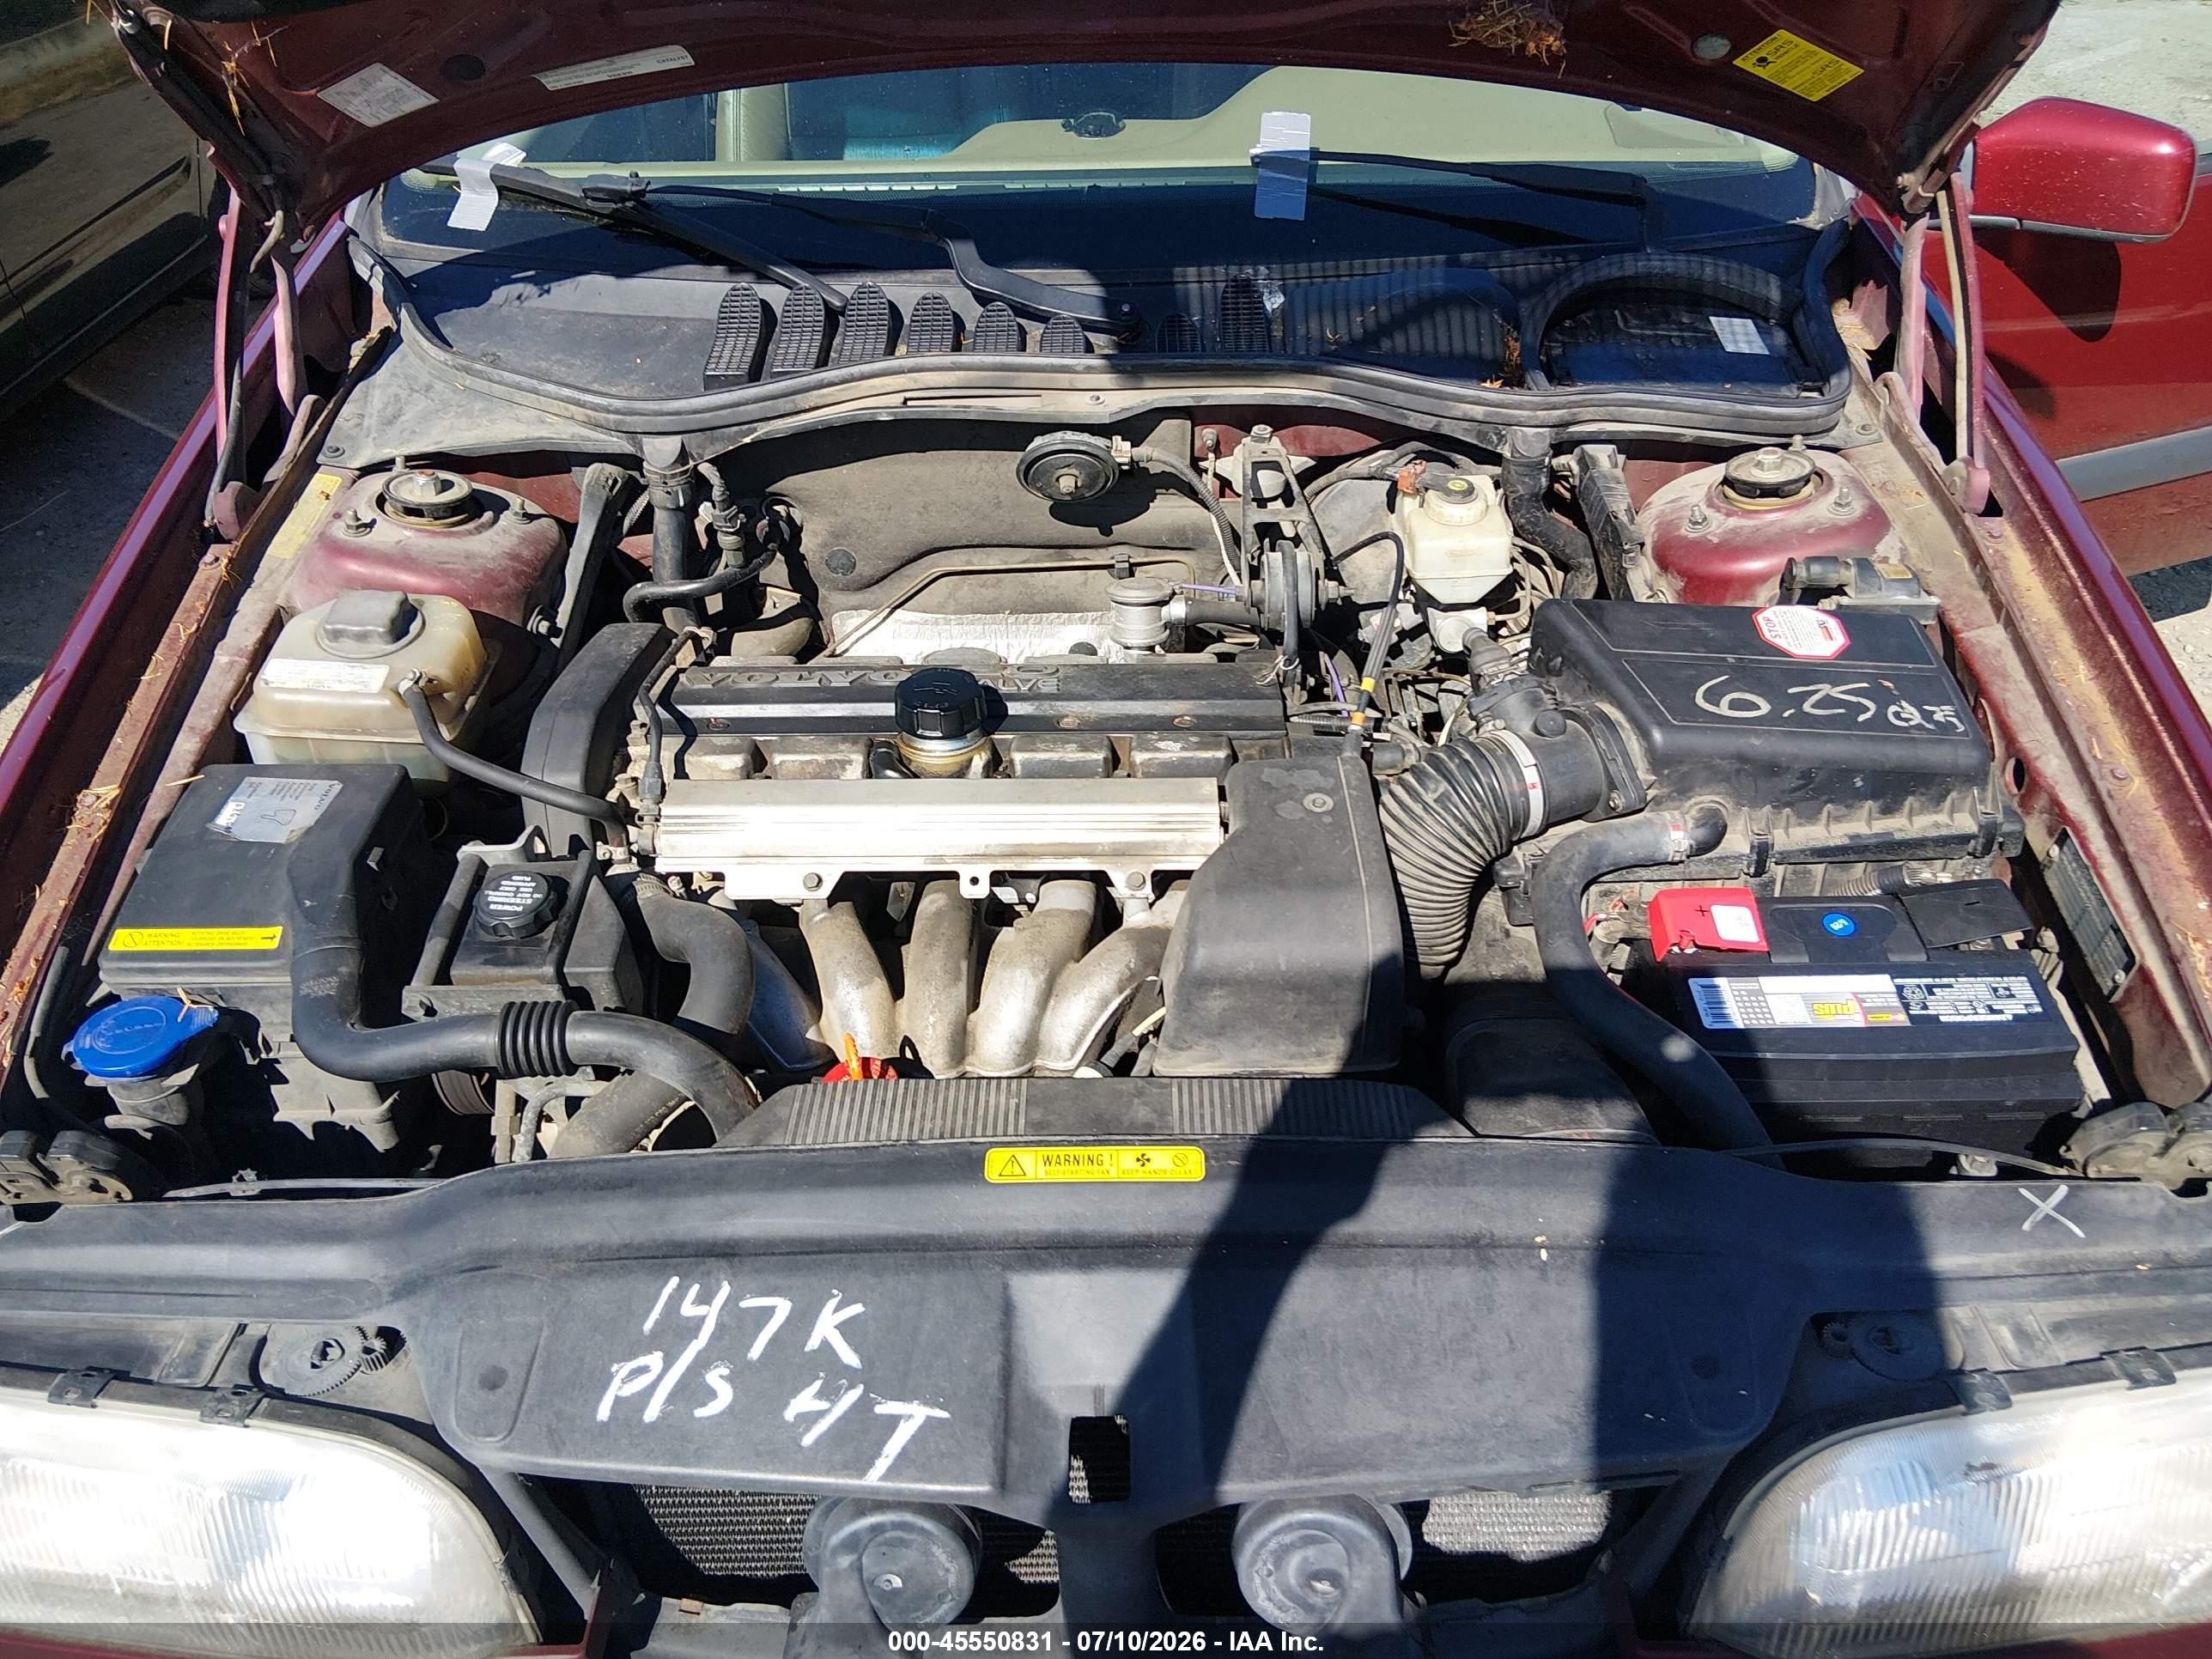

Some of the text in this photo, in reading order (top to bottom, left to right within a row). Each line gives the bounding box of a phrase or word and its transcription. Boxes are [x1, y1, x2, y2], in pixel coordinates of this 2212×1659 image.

[1766, 40, 1795, 57] SRS
[1813, 59, 1840, 76] SRS
[1762, 617, 1782, 639] STOP
[687, 671, 912, 688] VOLVO
[976, 678, 1060, 693] ALVE
[1695, 675, 1877, 722] 6.25
[314, 783, 335, 811] VOLVO
[1813, 999, 1856, 1016] plus
[1042, 1153, 1104, 1167] WARNING
[597, 1340, 735, 1423] P/S
